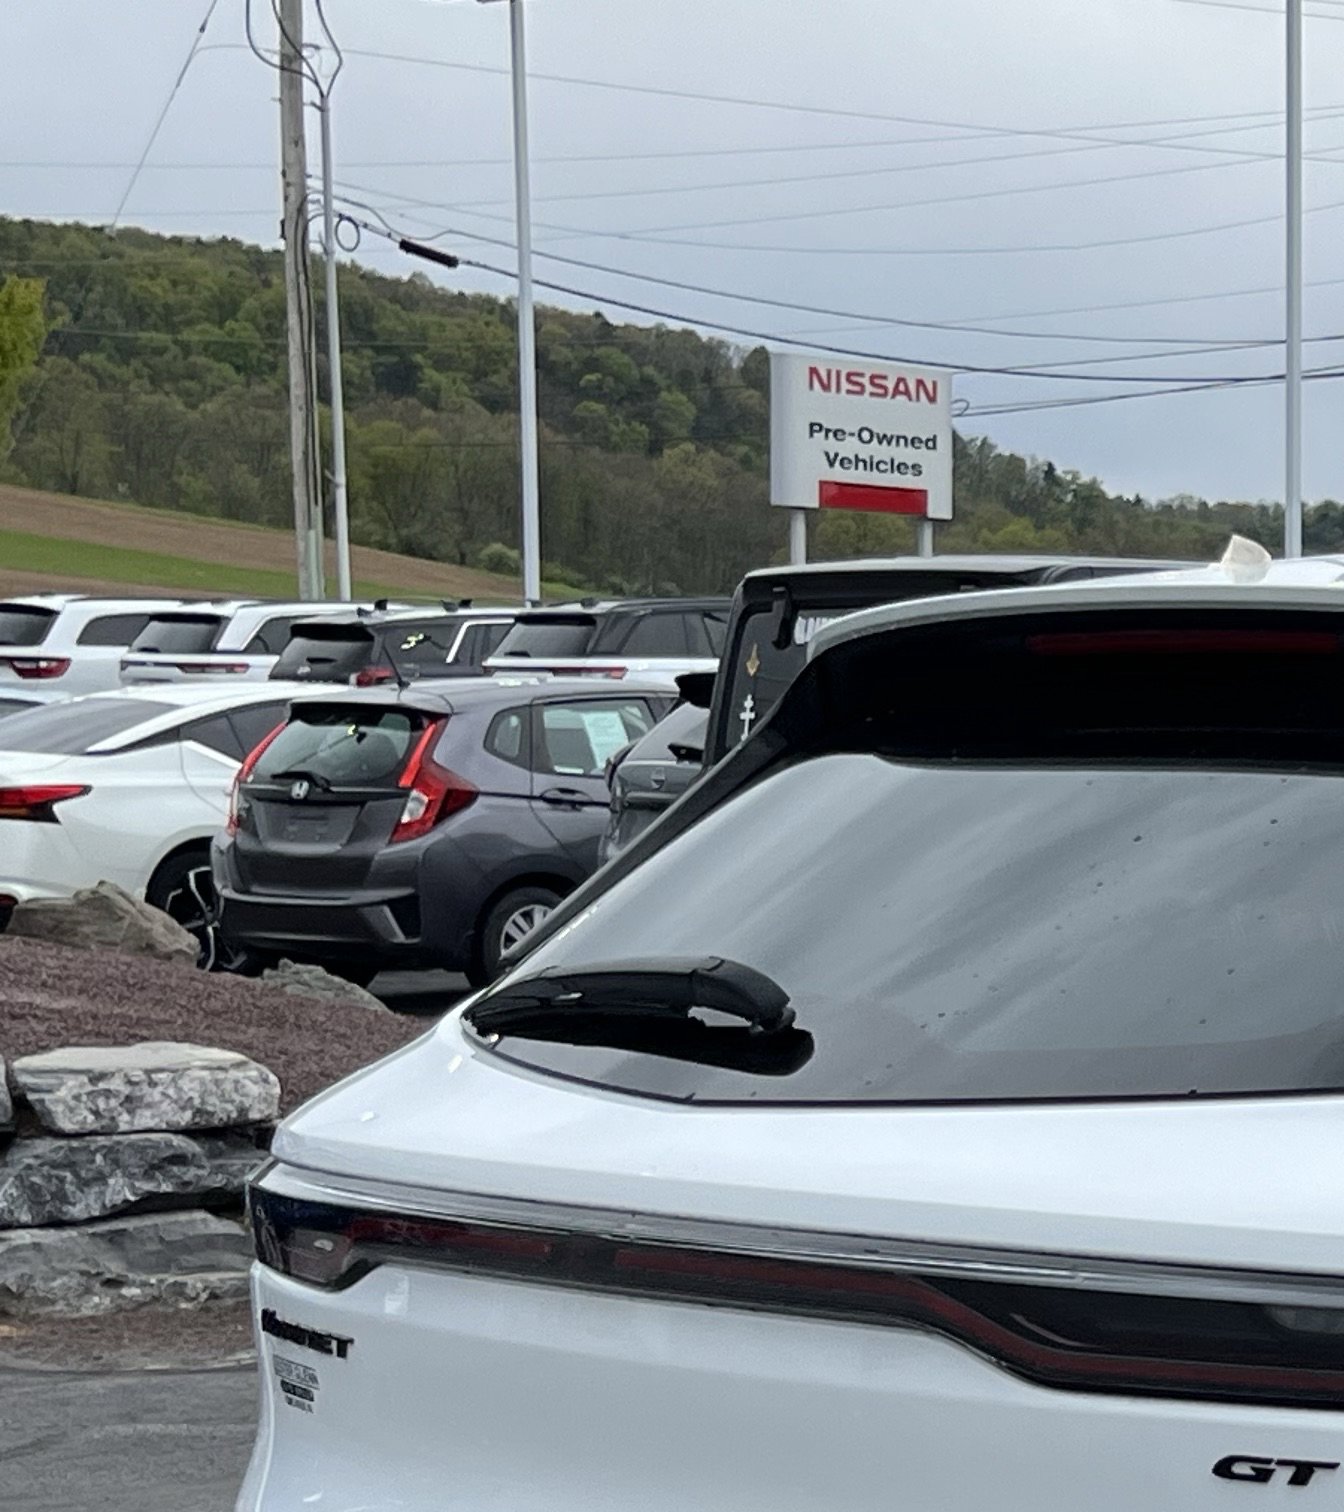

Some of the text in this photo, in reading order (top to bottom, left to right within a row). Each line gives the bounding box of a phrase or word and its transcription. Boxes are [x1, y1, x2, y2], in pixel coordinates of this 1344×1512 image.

[808, 366, 938, 404] NISSAN
[808, 421, 938, 450] Pre-Owned
[824, 450, 923, 477] Vehicles
[1211, 1455, 1341, 1486] GT
